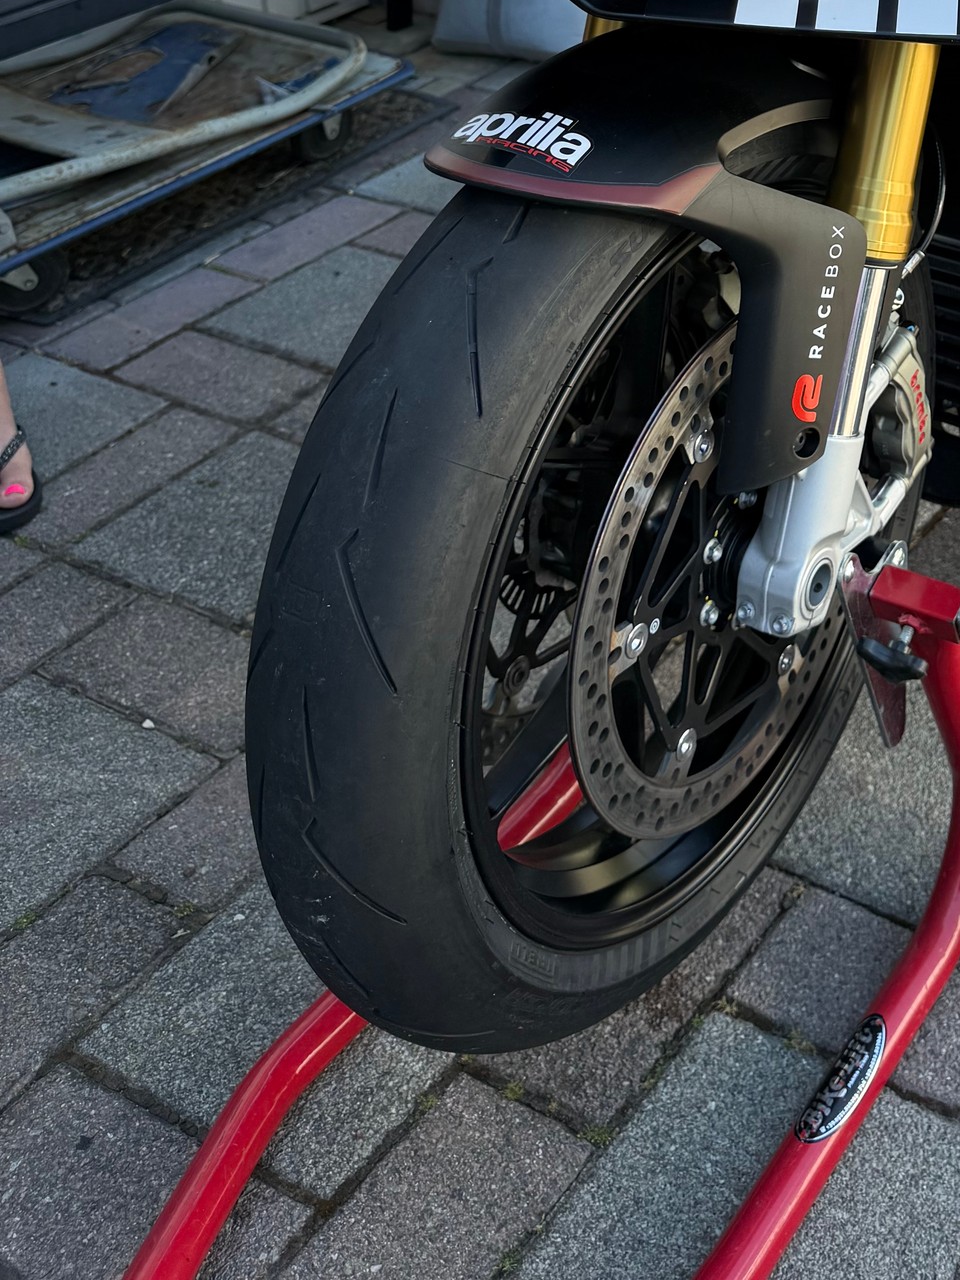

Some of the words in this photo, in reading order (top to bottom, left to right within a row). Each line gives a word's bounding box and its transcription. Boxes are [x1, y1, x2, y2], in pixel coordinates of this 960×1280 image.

[453, 111, 593, 167] aprilia
[475, 135, 574, 173] RACING
[808, 225, 846, 359] RACEBOX
[909, 368, 926, 445] brembo
